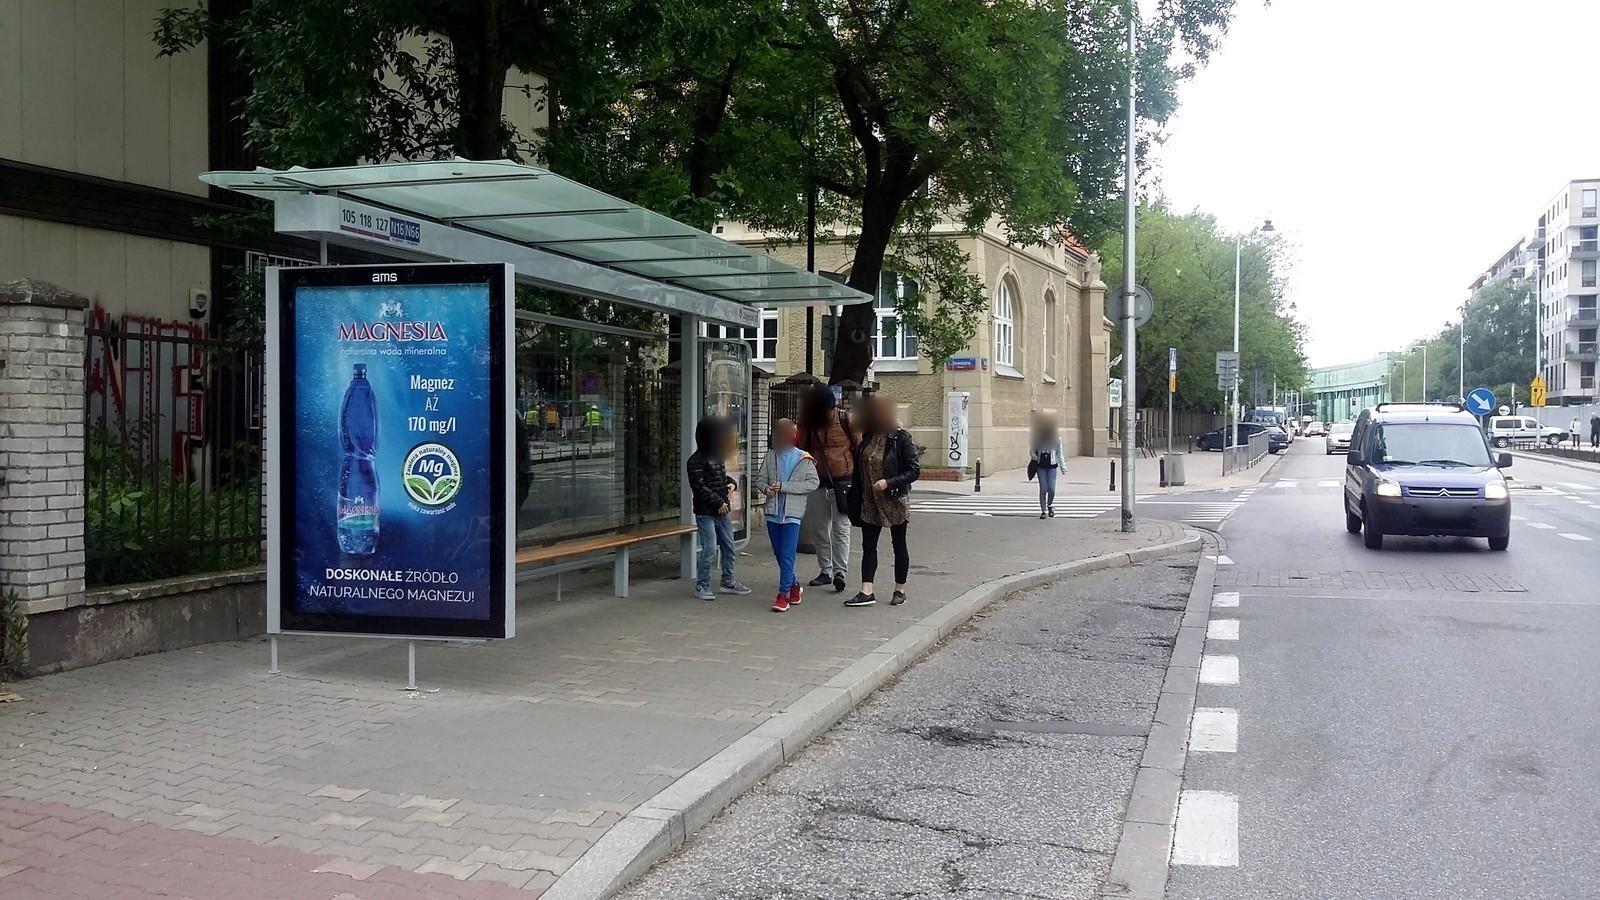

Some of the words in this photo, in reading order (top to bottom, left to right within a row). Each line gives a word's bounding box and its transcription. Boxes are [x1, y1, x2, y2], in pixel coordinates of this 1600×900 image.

[342, 208, 356, 224] 105
[360, 213, 372, 228] 118
[376, 217, 389, 232] 127
[390, 220, 405, 235] N16
[405, 224, 420, 239] N66
[372, 273, 398, 282] ams
[338, 320, 448, 341] MAGNESIA
[340, 346, 377, 356] naturalna
[379, 346, 402, 356] woda
[404, 346, 447, 356] mineralna
[410, 374, 455, 392] Magnez
[425, 394, 439, 412] AŻ
[407, 416, 427, 432] 170
[429, 416, 456, 434] mg/l
[418, 459, 444, 477] Mg
[325, 568, 403, 582] DOSKONAŁE
[405, 568, 459, 584] ŹRÓDŁO
[309, 585, 404, 600] NATURALNEGO
[407, 588, 475, 603] MAGNEZU!
